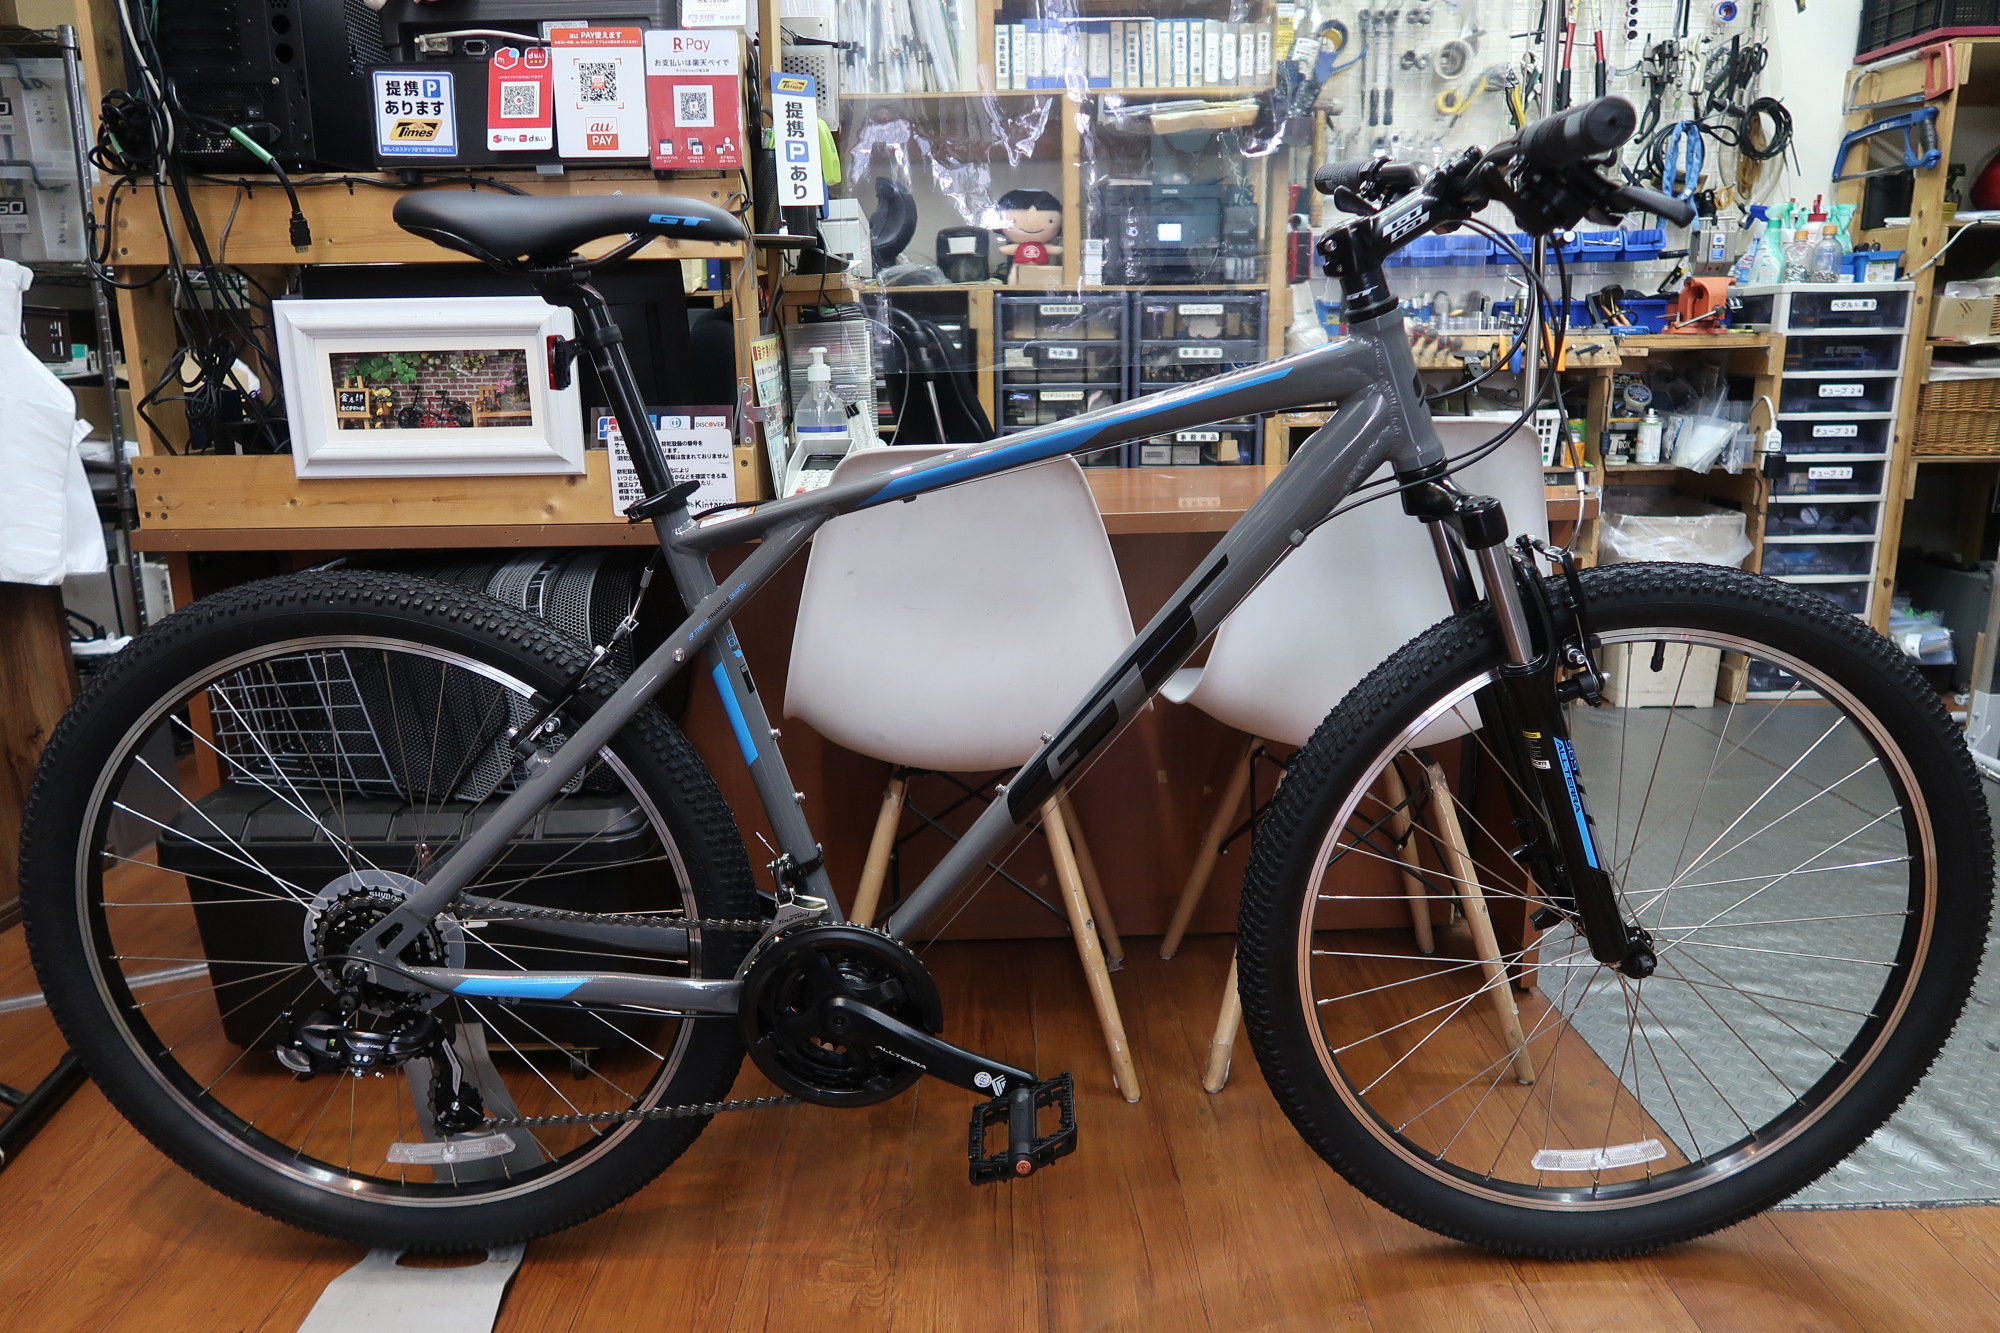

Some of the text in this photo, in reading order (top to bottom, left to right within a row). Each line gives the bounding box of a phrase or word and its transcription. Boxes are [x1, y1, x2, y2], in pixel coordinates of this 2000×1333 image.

[581, 31, 622, 39] PAY使えます
[686, 37, 710, 52] Pay
[654, 58, 730, 67] お支払いは楽天ペイで
[385, 100, 444, 115] あります
[398, 125, 434, 138] Times
[590, 122, 613, 132] au
[528, 134, 546, 142] d払い
[592, 135, 613, 146] PAY
[648, 214, 711, 226] GT
[694, 581, 747, 634] TRIPLE TRIANGLE DESIGN
[1556, 740, 1581, 813] ALLTERRA
[778, 911, 810, 924] Tourney
[355, 1042, 385, 1050] Tourney
[875, 1045, 927, 1070] ALLTERRA
